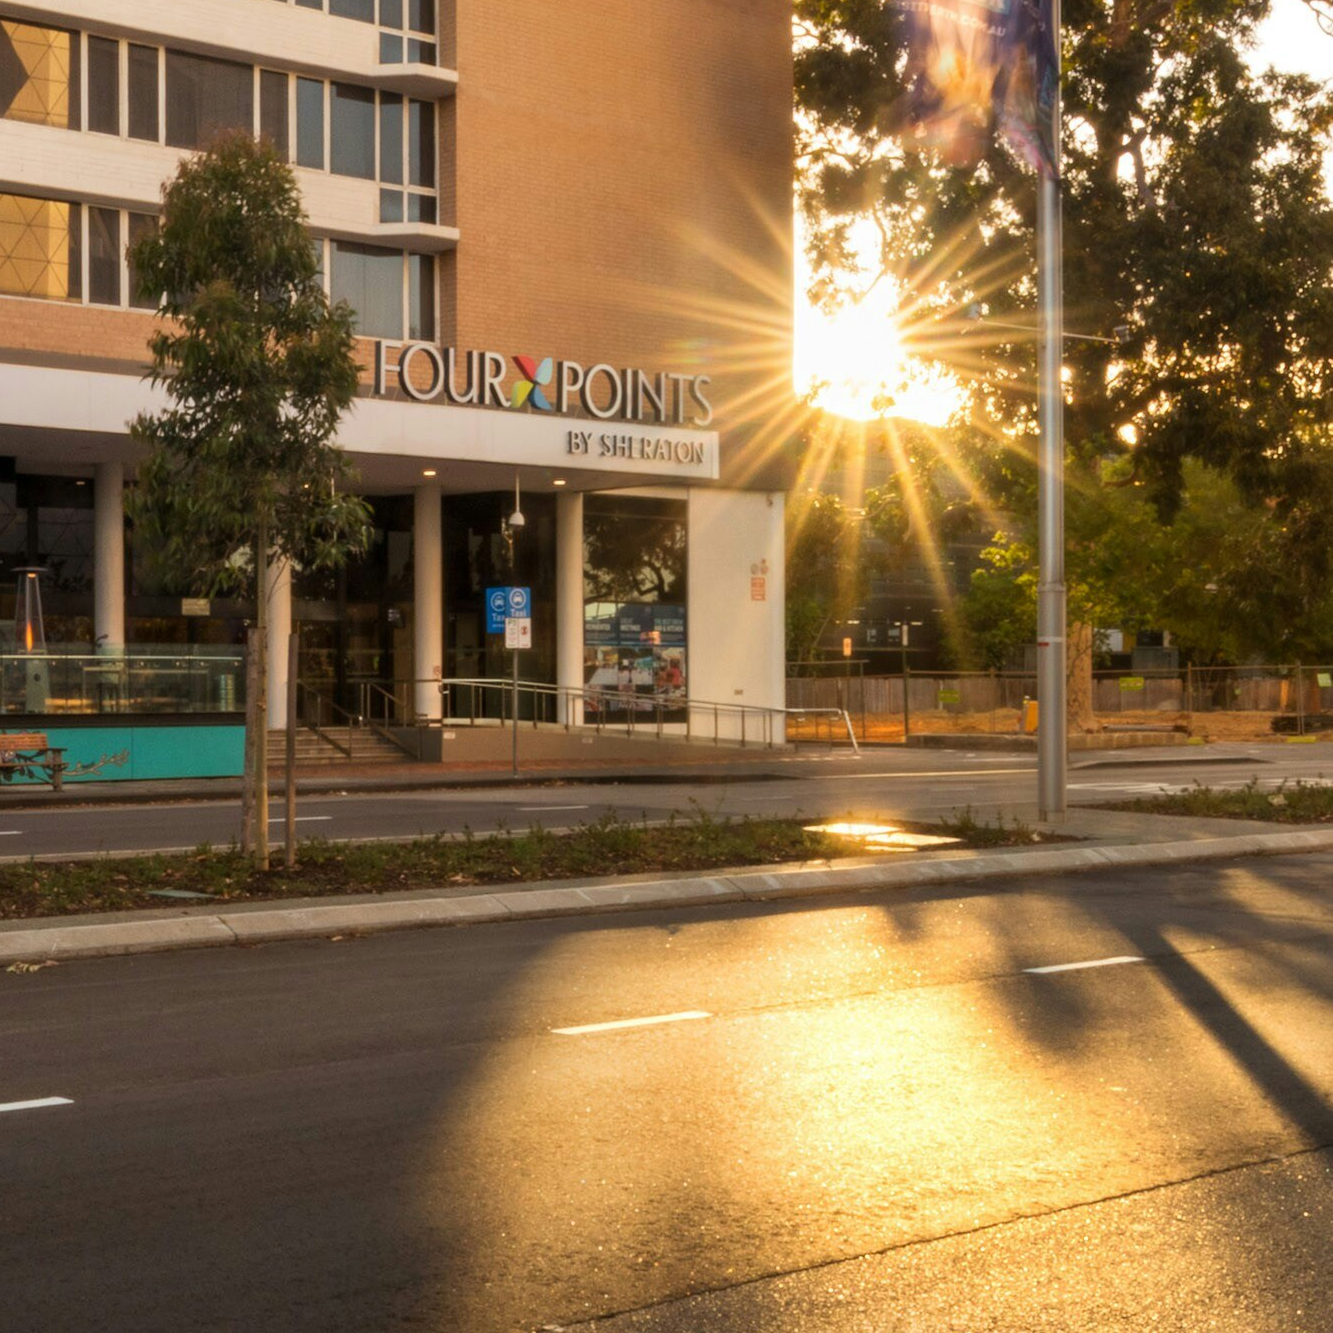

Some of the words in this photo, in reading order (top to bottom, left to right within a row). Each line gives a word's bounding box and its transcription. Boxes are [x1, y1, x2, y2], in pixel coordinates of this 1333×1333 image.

[376, 340, 511, 409] FOUR
[557, 361, 713, 426] POINTS
[567, 430, 593, 454] BY
[601, 434, 704, 464] SHERATON
